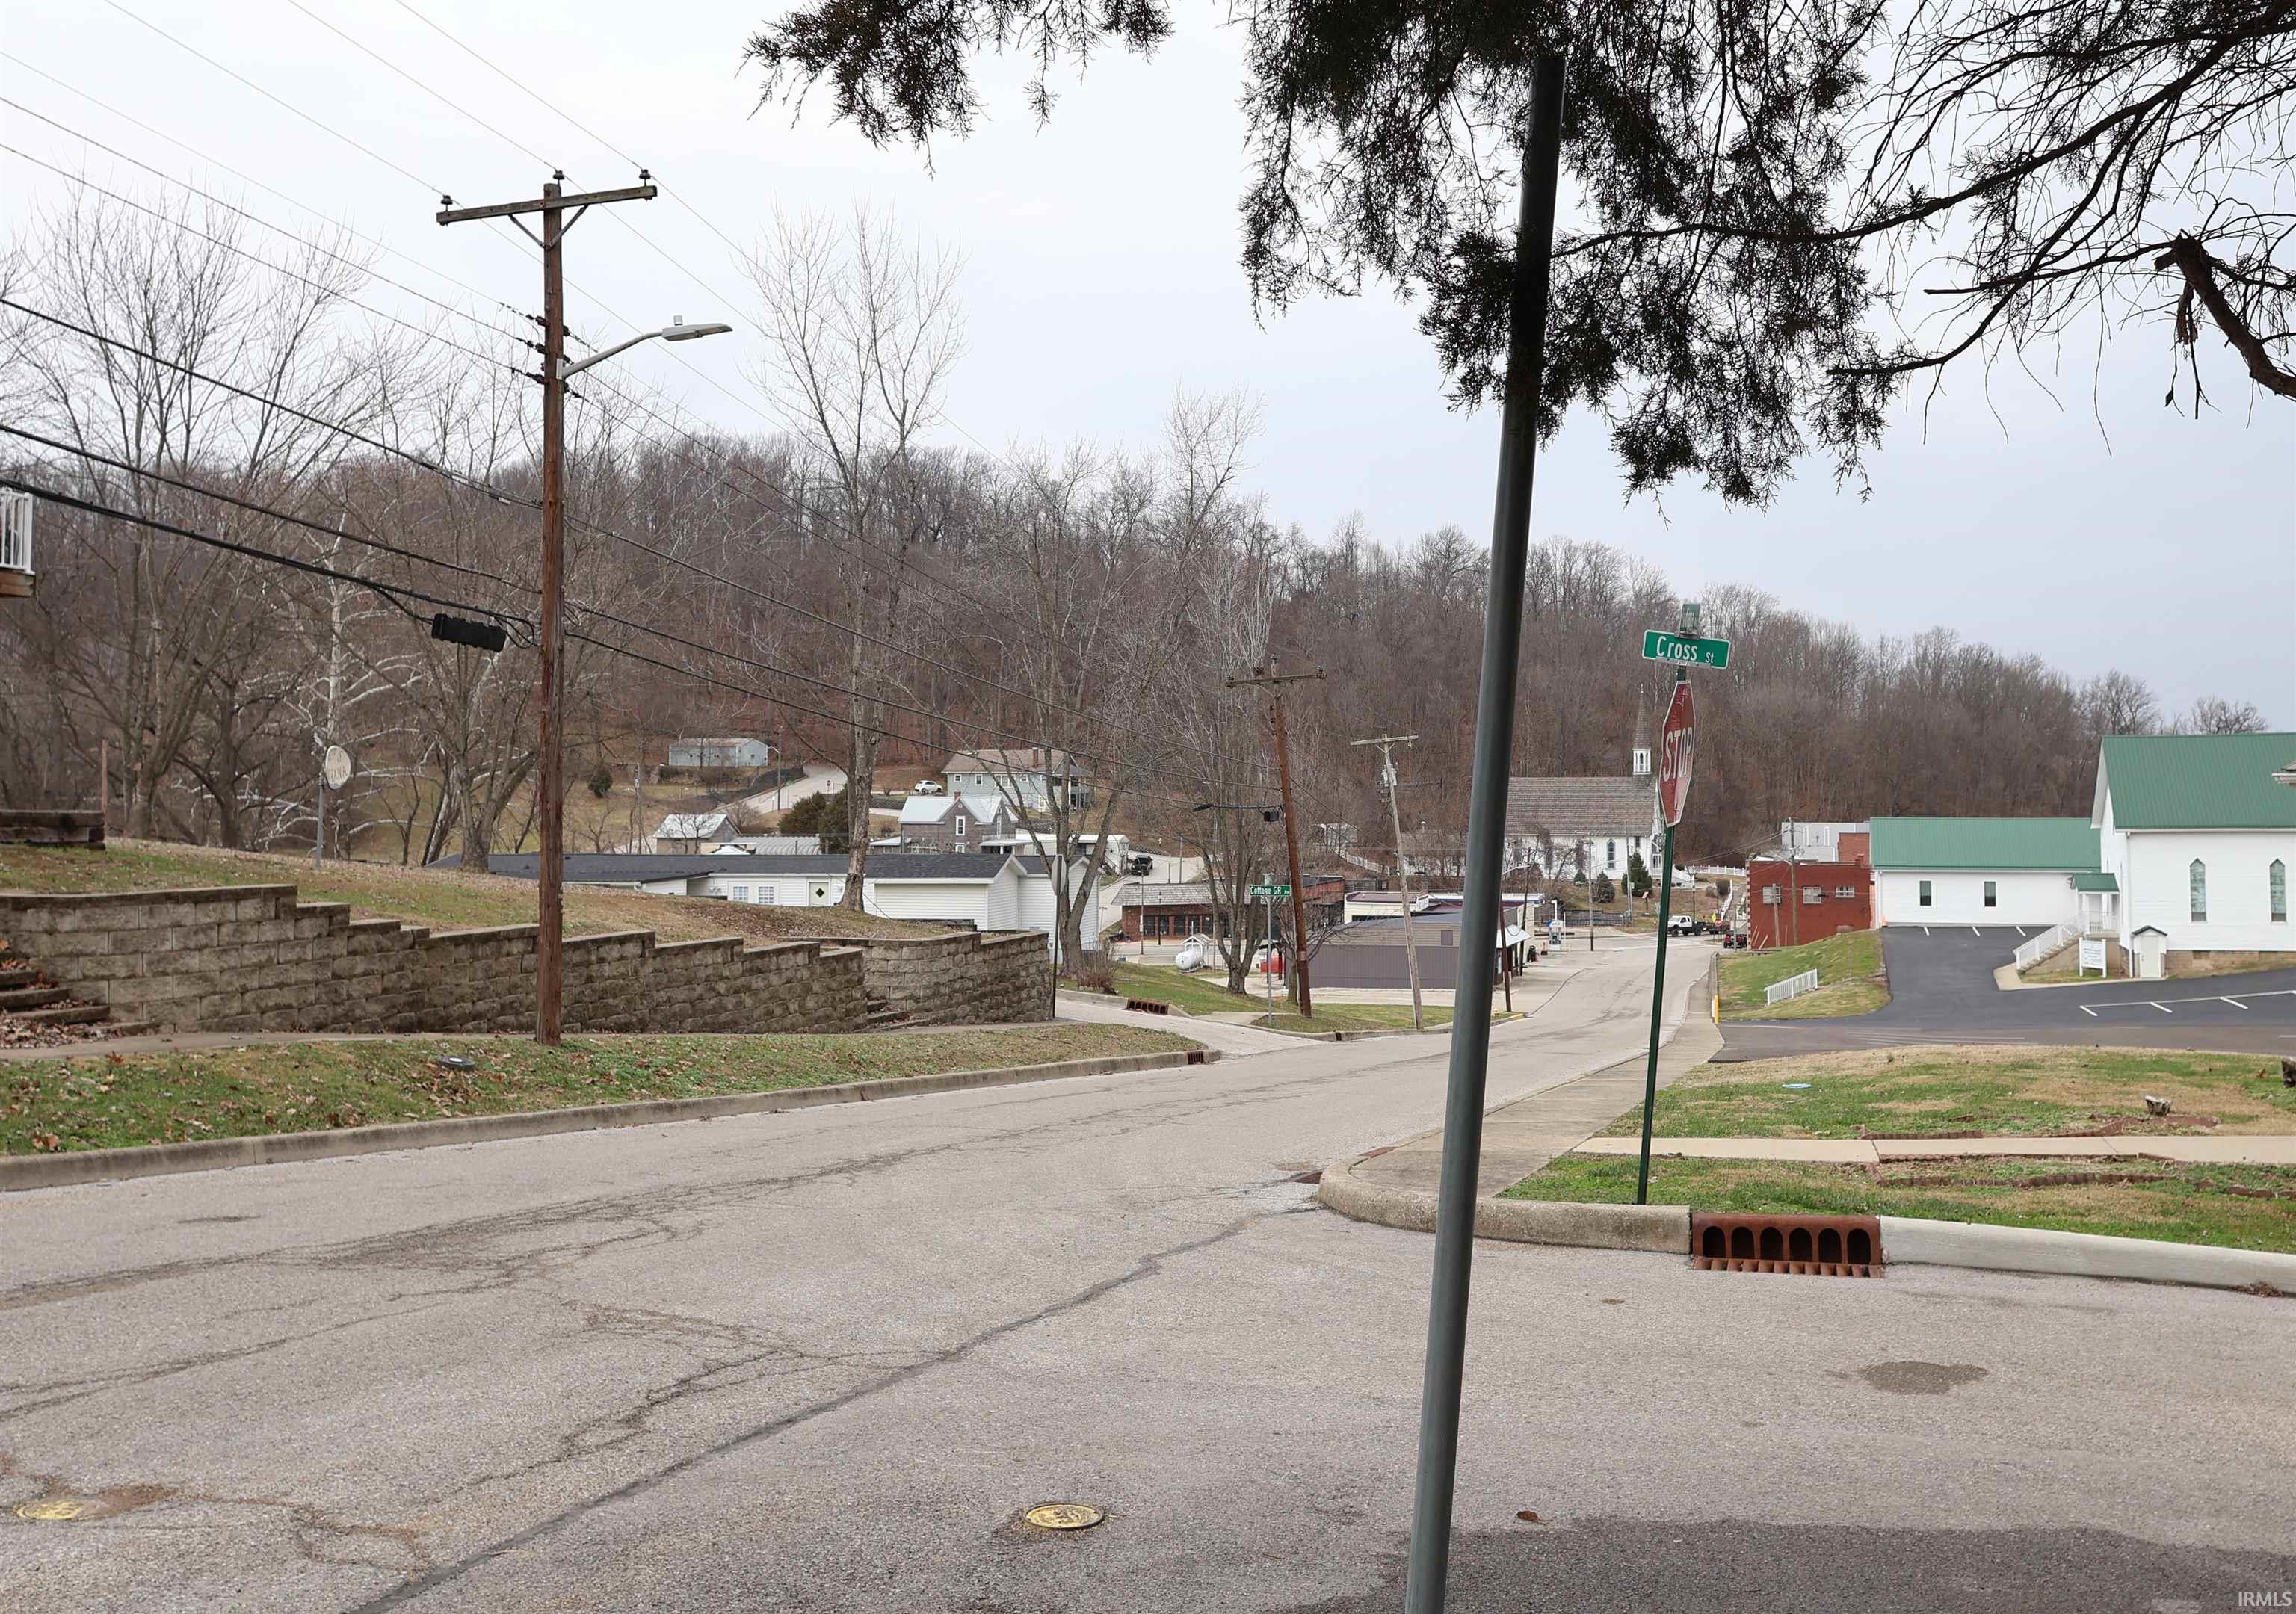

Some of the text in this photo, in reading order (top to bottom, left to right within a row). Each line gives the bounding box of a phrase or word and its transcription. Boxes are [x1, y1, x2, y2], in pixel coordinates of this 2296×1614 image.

[1656, 635, 1715, 664] Cross St
[1662, 726, 1693, 782] STOP
[1250, 886, 1271, 895] Cottage
[1273, 886, 1281, 894] GR
